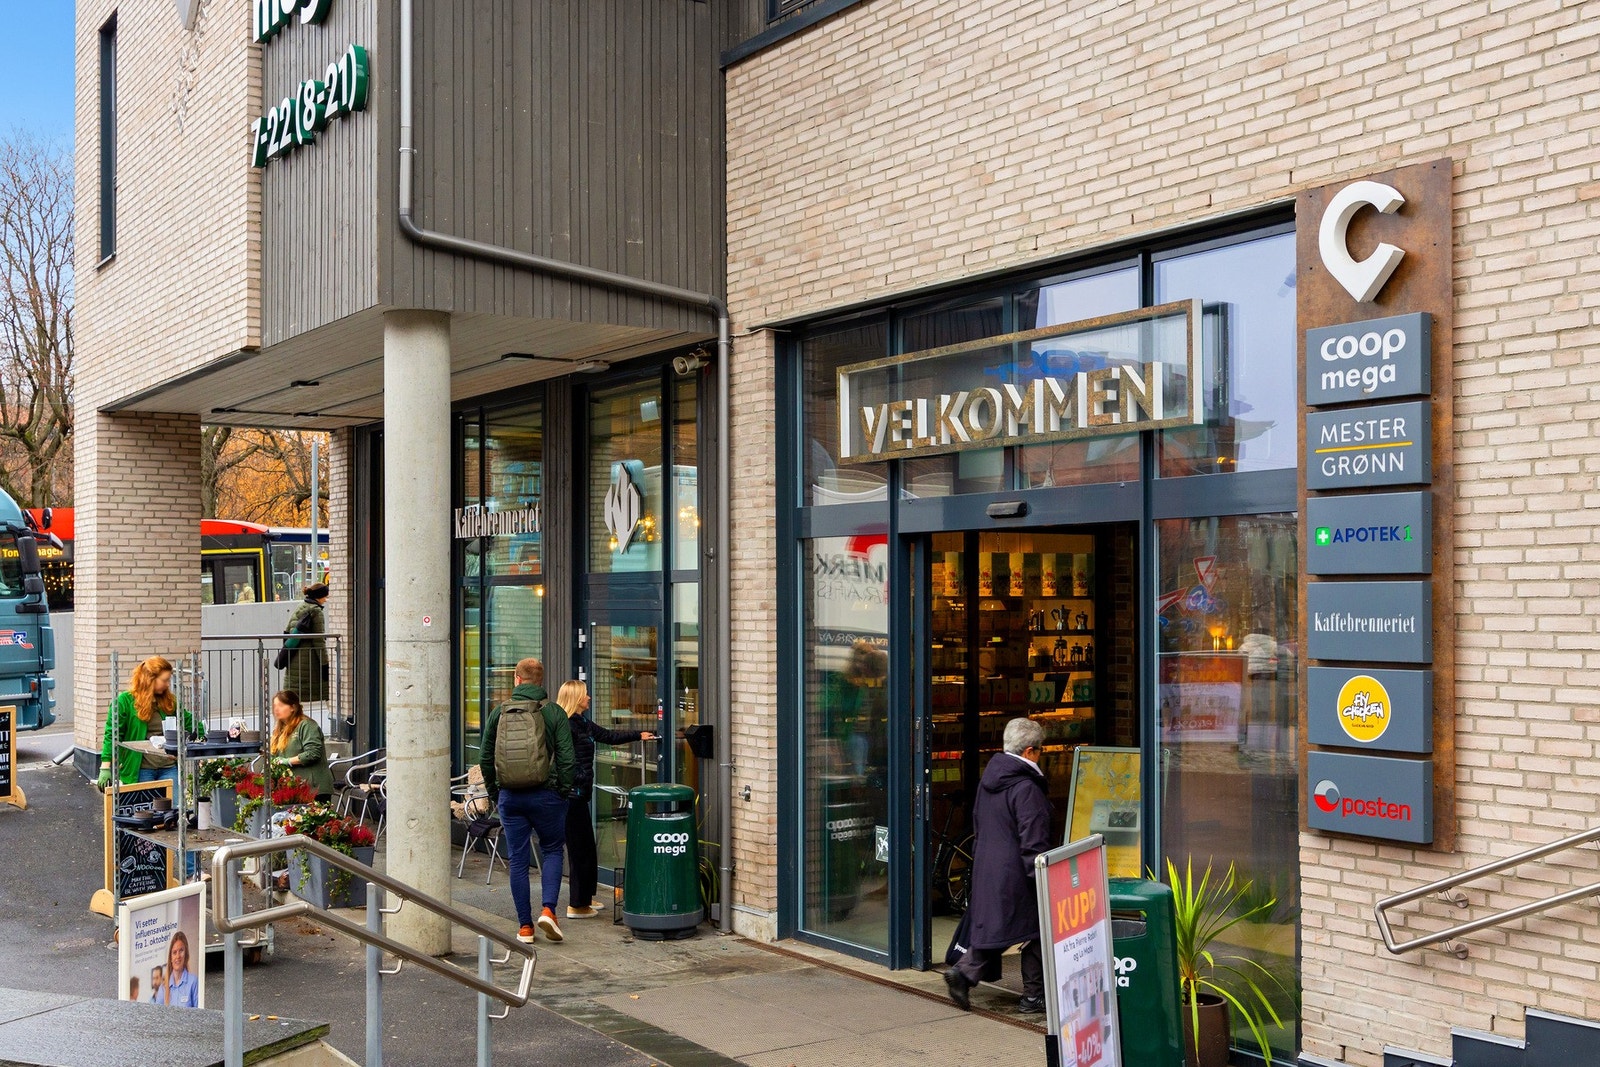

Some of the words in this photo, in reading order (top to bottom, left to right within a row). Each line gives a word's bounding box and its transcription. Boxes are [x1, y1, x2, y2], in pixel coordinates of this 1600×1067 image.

[1320, 328, 1406, 361] coop
[1321, 364, 1396, 393] mega
[859, 361, 1163, 454] VELKOMMEN
[1320, 417, 1406, 444] MESTER
[1321, 452, 1404, 477] GRØNN
[455, 502, 541, 538] Kaffebrenneriet
[1333, 526, 1401, 543] APOTEK
[1404, 525, 1413, 541] 1
[1314, 612, 1416, 633] Kaffebrenneriet
[1342, 797, 1412, 821] posten
[653, 832, 689, 845] coop
[653, 845, 687, 857] mega
[1057, 888, 1096, 934] KUPP
[135, 920, 142, 929] Vi
[142, 918, 158, 927] setter
[135, 922, 177, 940] influensavaksine
[135, 941, 143, 950] fra
[150, 932, 171, 946] oktober!
[1078, 1033, 1100, 1063] -40%
